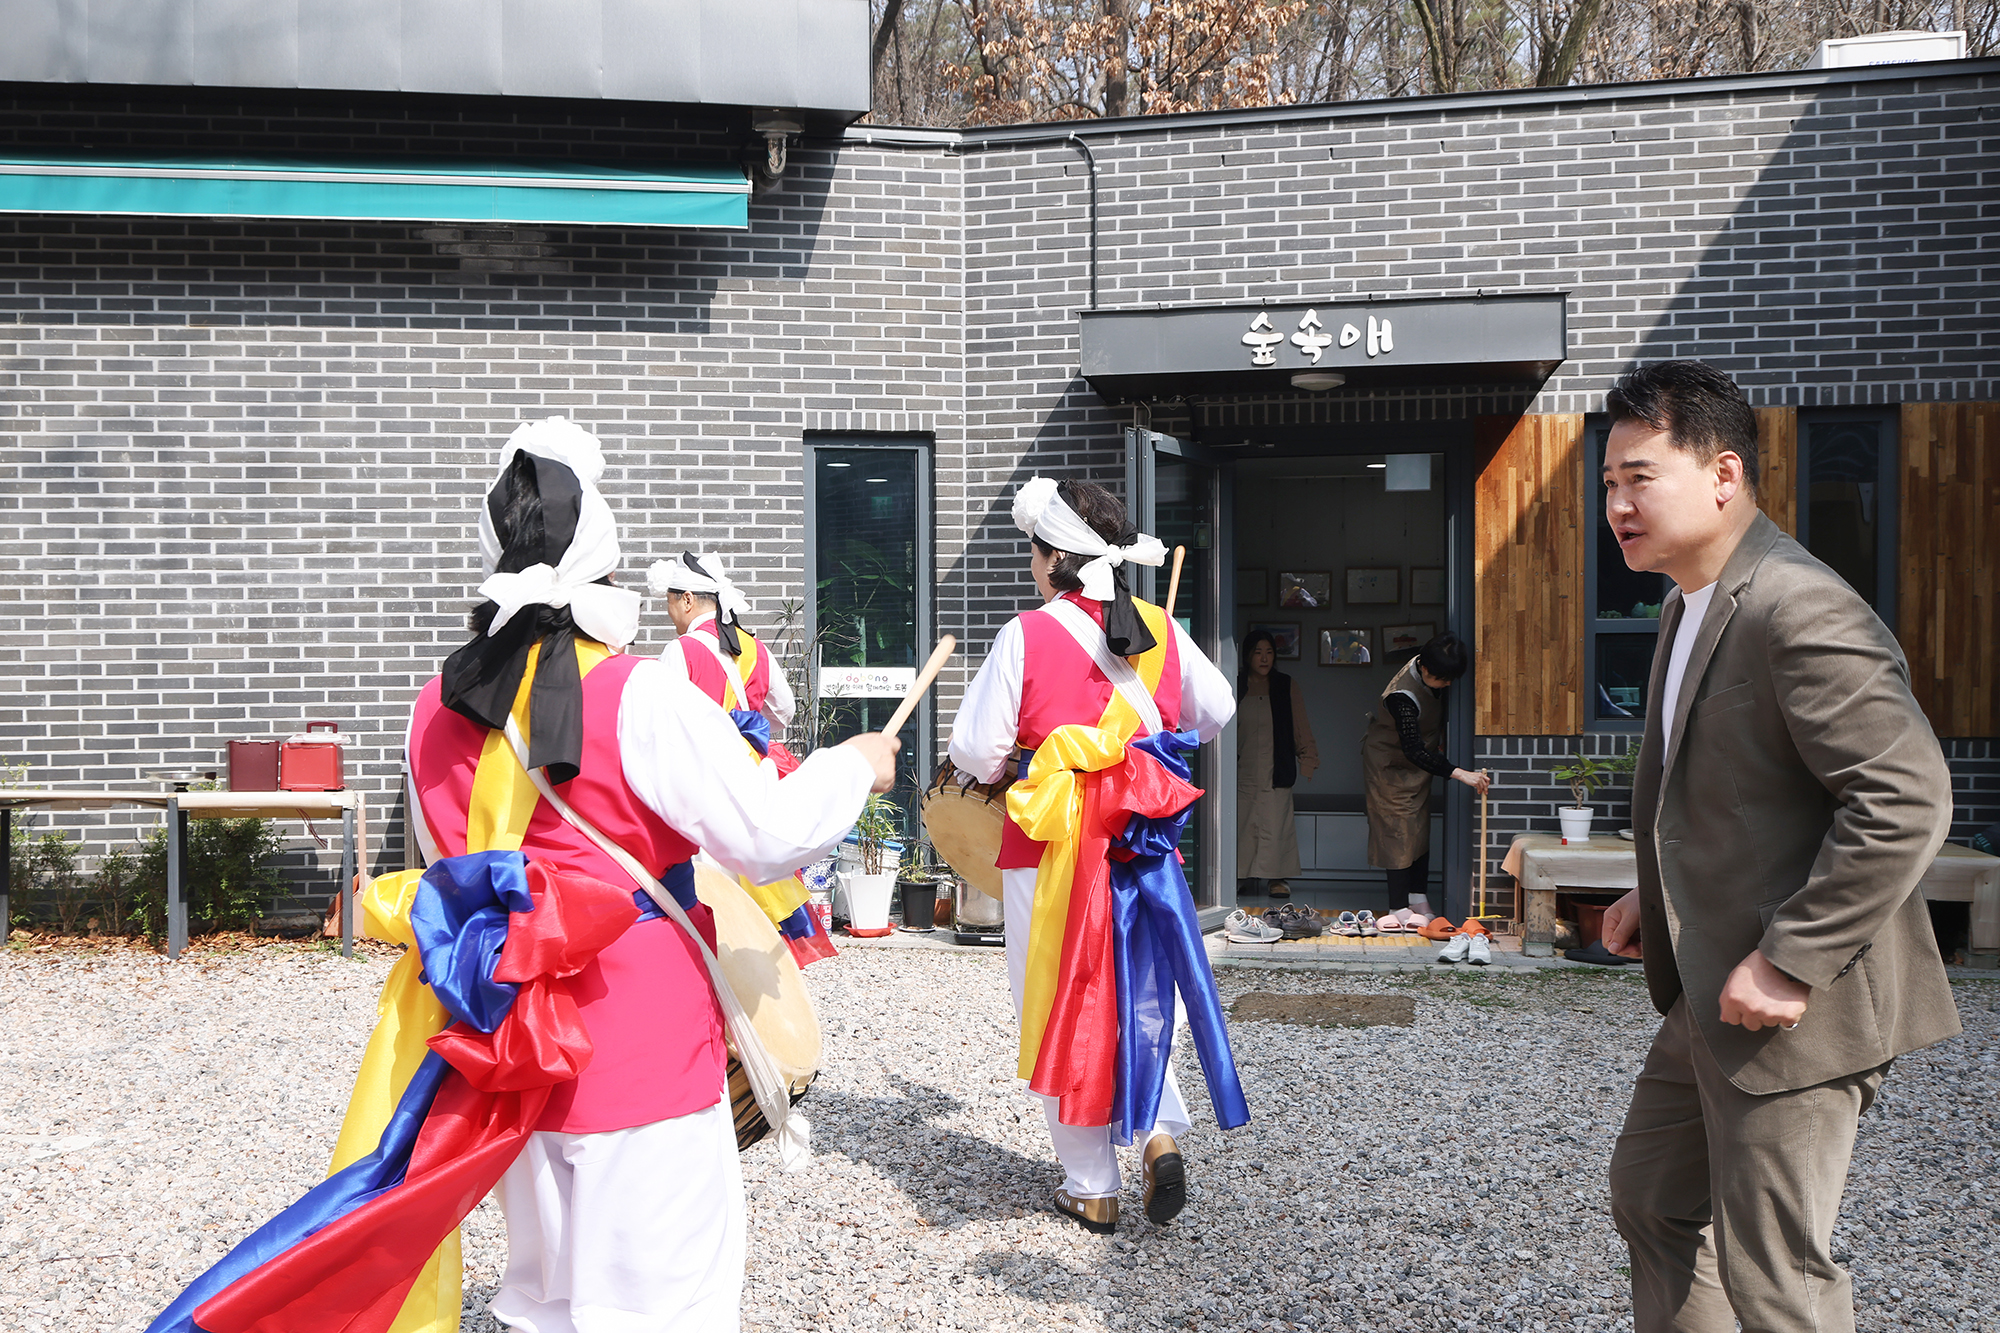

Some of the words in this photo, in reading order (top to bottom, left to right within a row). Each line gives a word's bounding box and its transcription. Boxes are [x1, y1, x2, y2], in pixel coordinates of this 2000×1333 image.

[1241, 308, 1394, 366] 숲속애
[845, 673, 889, 684] dobong
[894, 683, 908, 693] 도봉
